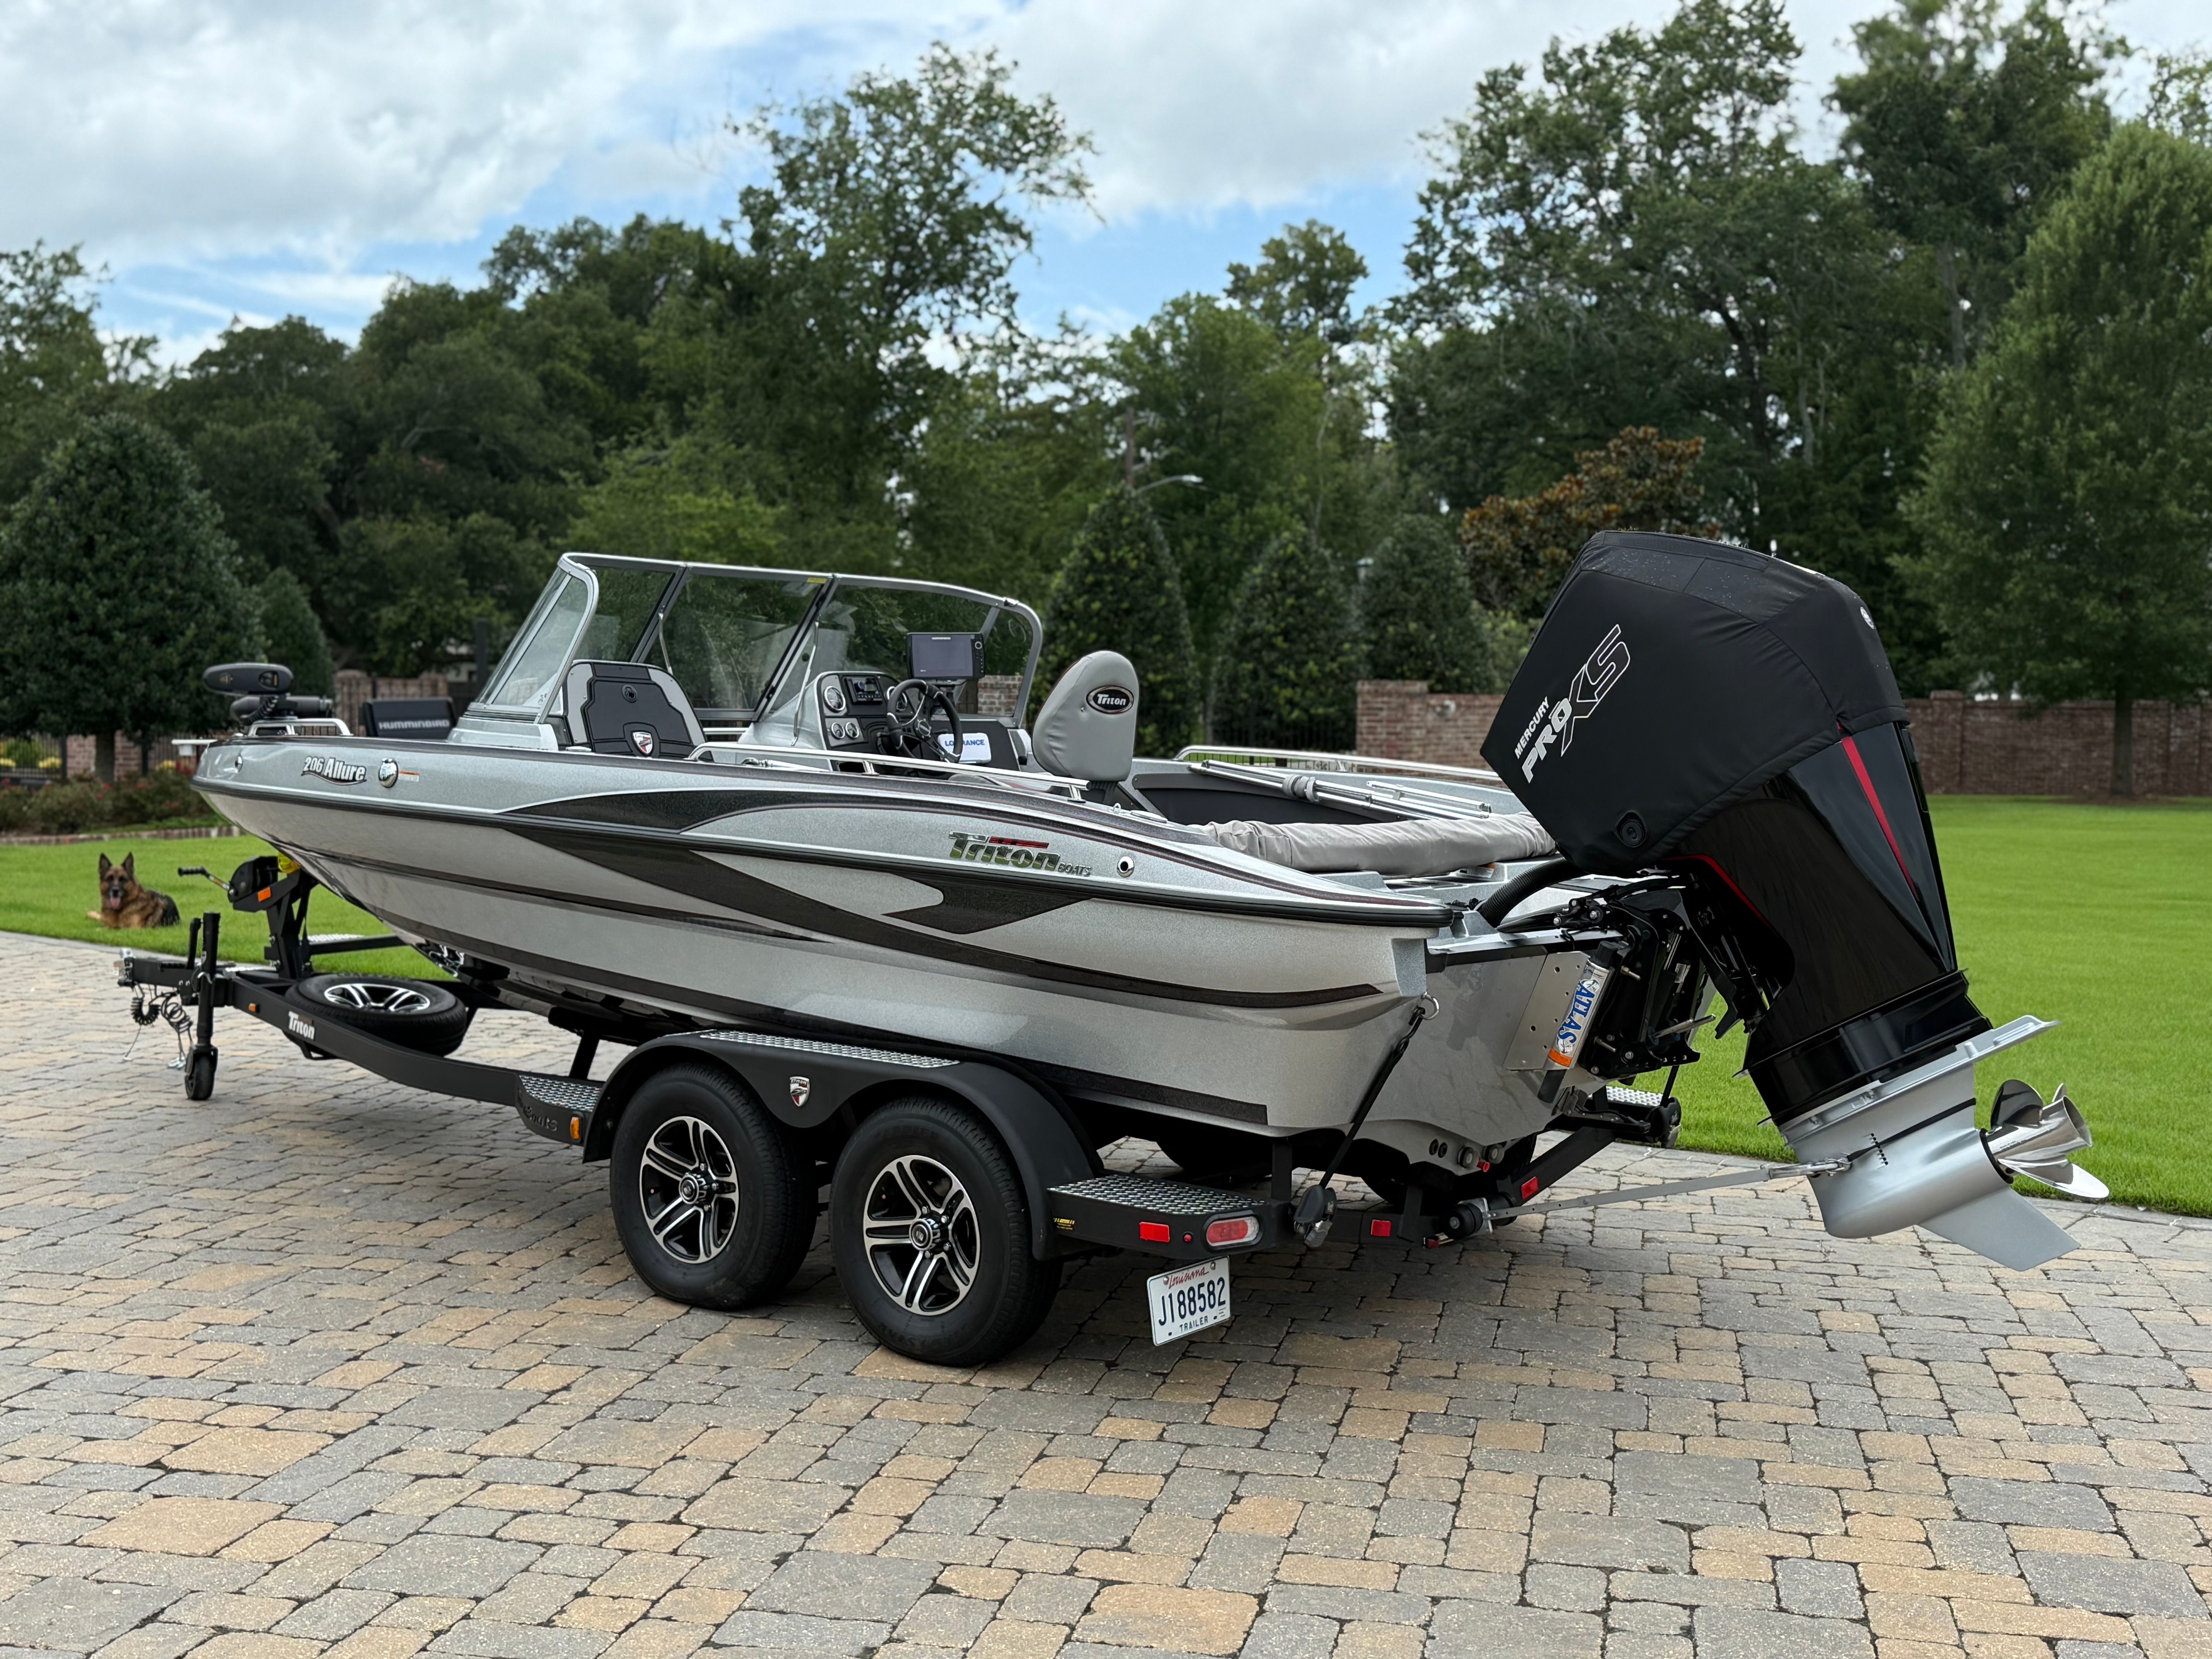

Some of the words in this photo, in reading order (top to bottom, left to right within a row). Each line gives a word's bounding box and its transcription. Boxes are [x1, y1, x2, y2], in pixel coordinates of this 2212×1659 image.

[1097, 694, 1127, 706] Triton
[1515, 696, 1549, 759] MERCURY
[303, 756, 325, 773] 206
[324, 757, 366, 781] Allure
[948, 832, 1061, 871] Triton
[1057, 862, 1093, 877] BOATS
[288, 1011, 315, 1040] Triton
[1558, 981, 1595, 1044] ATLAS
[1169, 1267, 1209, 1289] Louisiana
[1158, 1277, 1226, 1326] J188582
[1180, 1316, 1209, 1332] TRAILER
